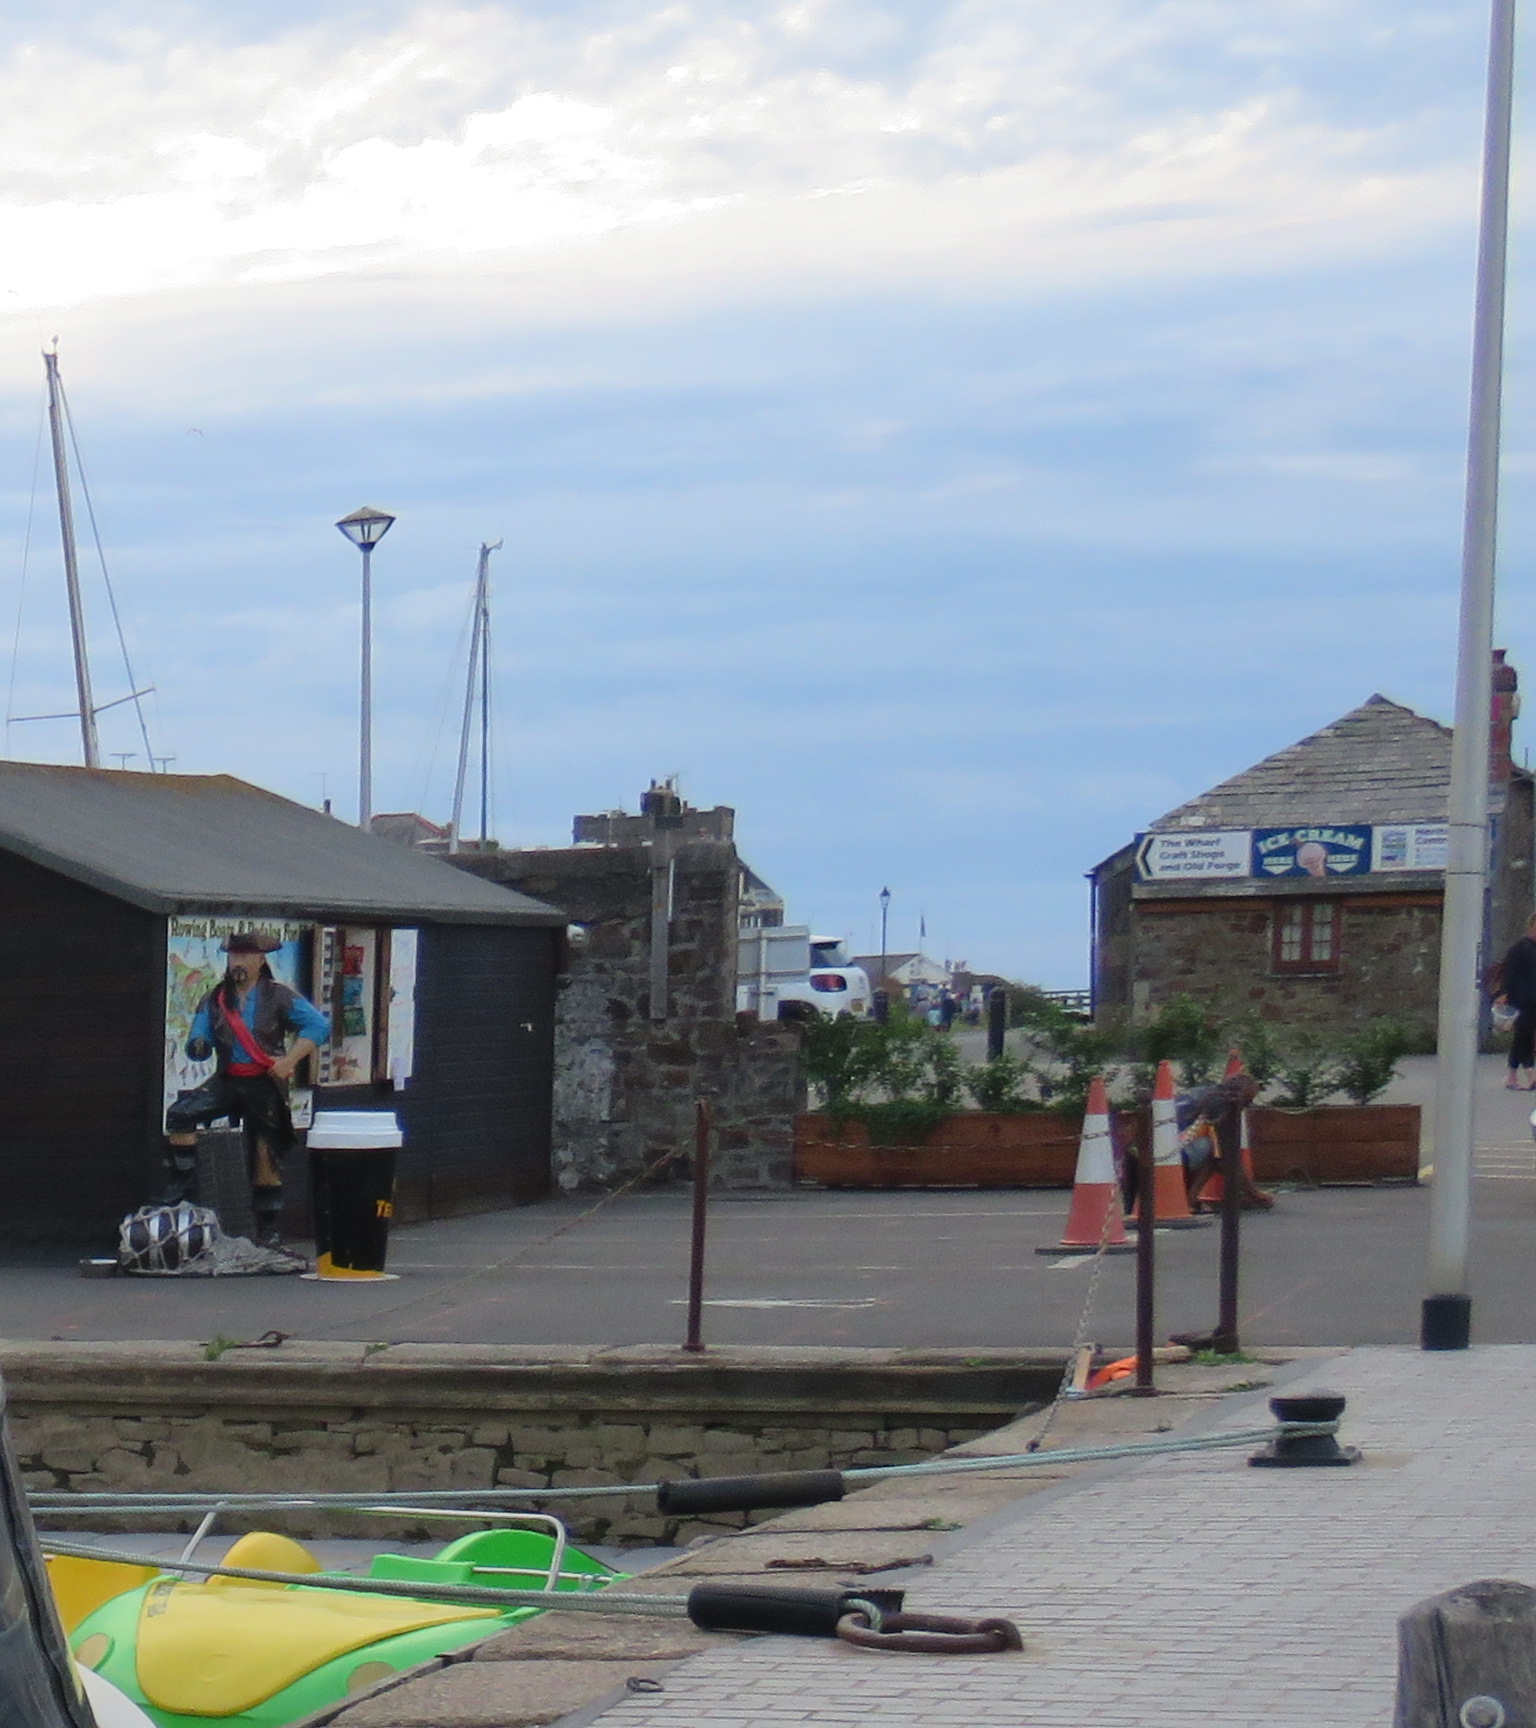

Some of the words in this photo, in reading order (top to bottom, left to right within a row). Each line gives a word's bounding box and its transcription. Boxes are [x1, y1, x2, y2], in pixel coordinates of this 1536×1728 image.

[1161, 839, 1181, 848] The
[1185, 837, 1221, 848] Wharf
[1257, 832, 1290, 854] ICE
[1295, 828, 1365, 851] CREAM
[170, 916, 208, 941] Rowing
